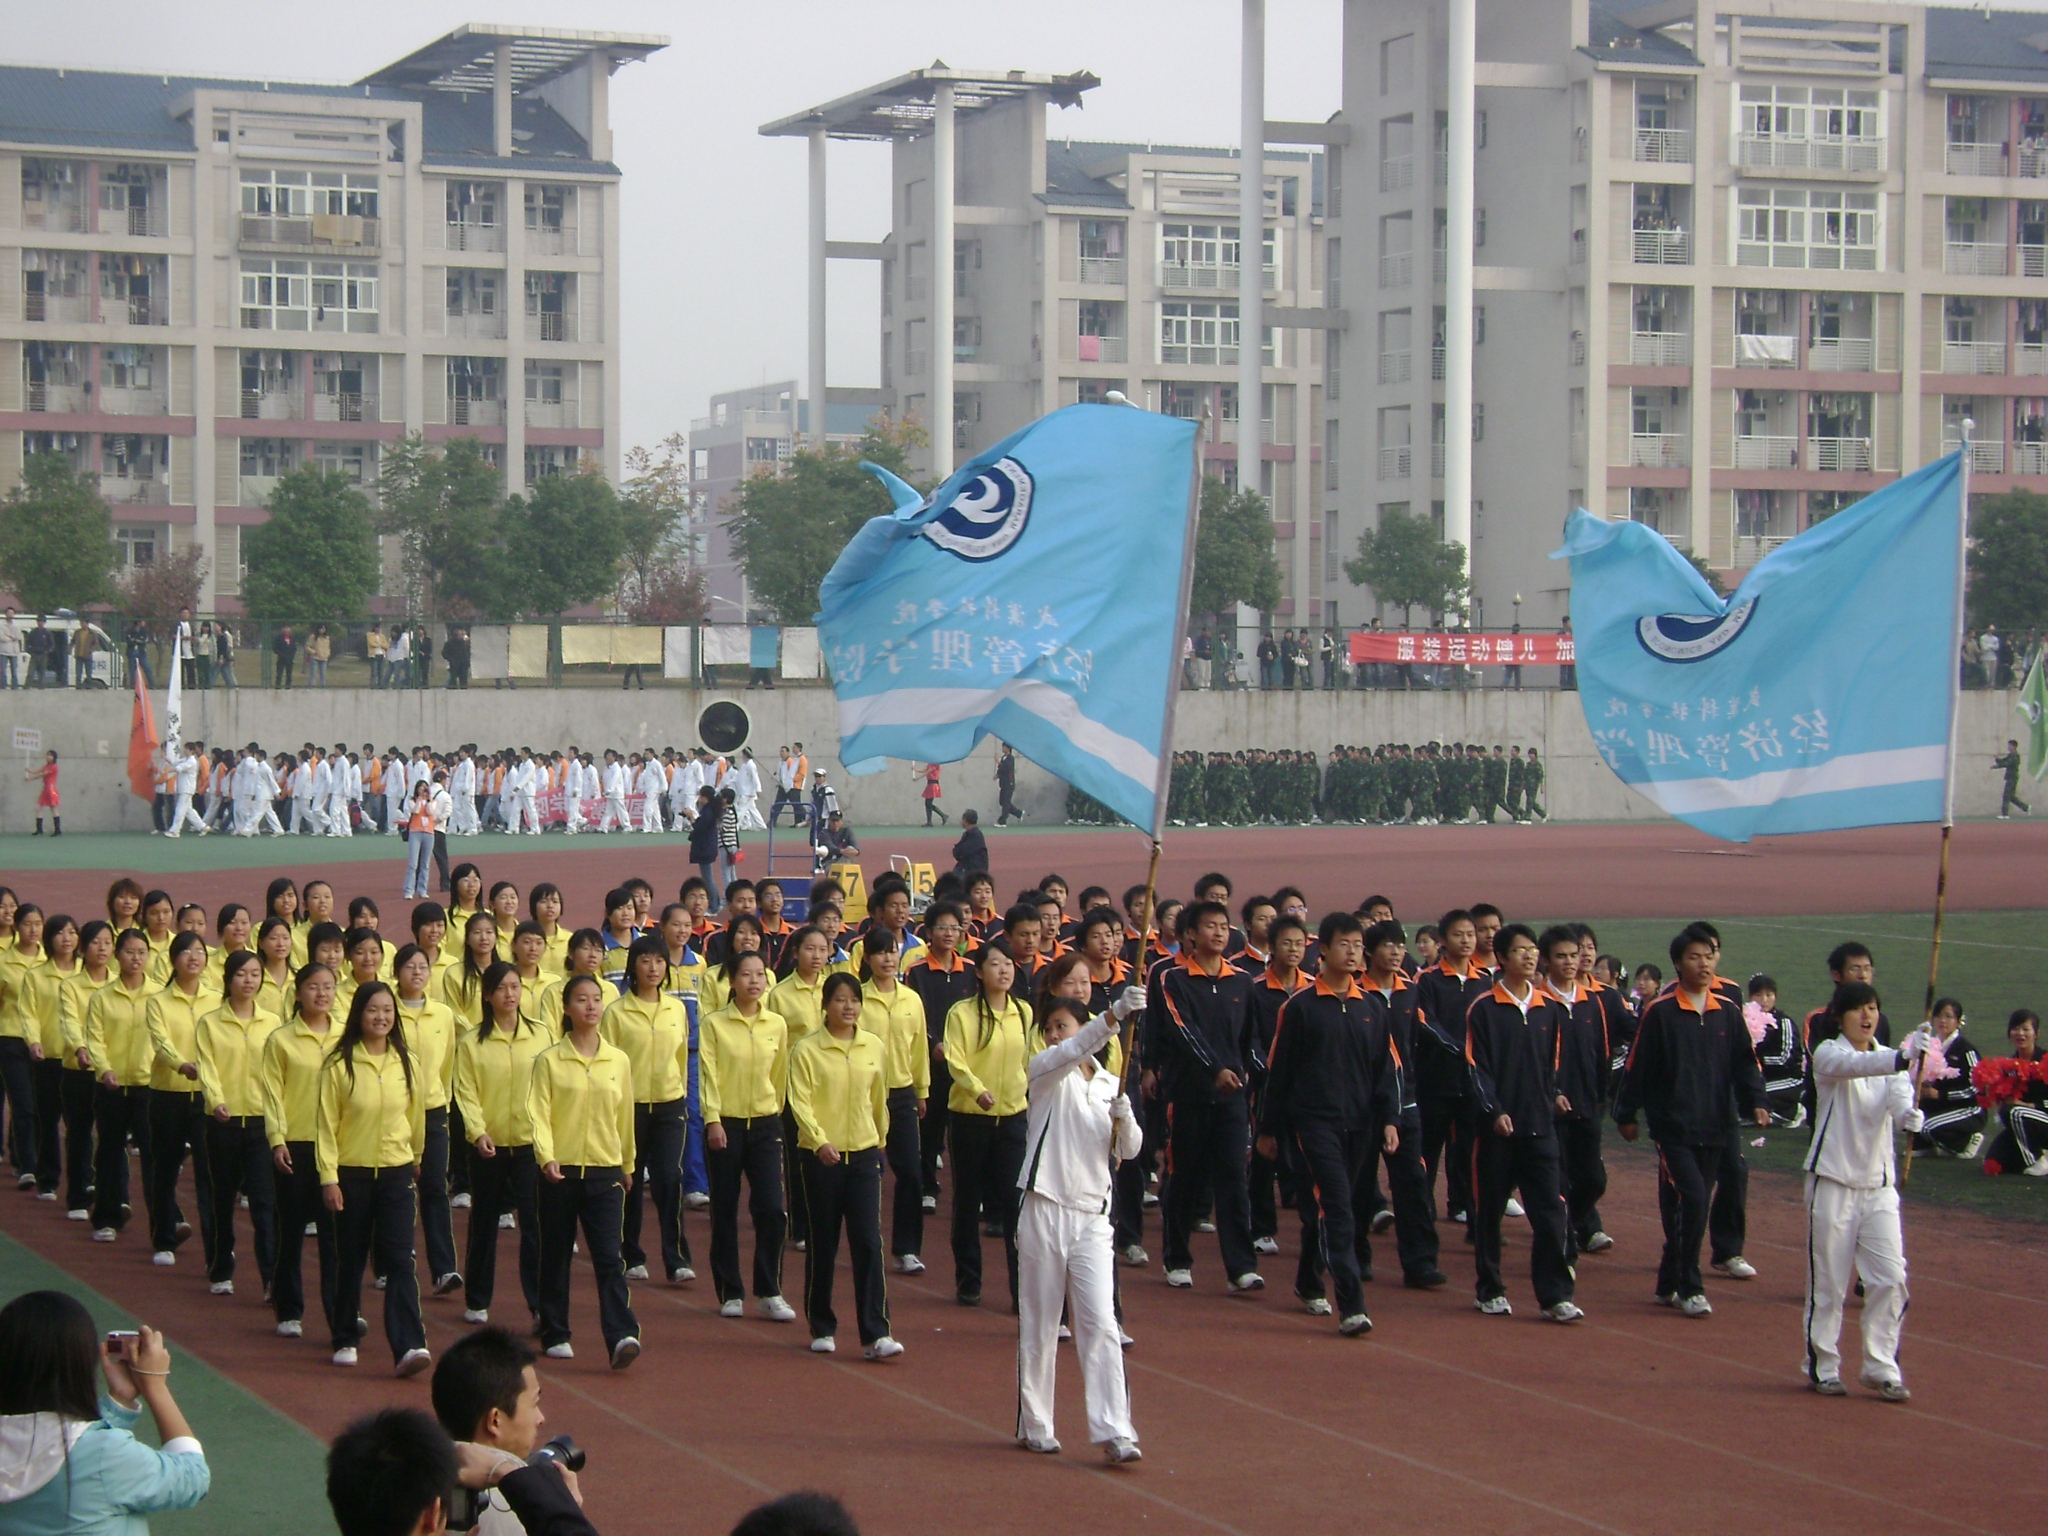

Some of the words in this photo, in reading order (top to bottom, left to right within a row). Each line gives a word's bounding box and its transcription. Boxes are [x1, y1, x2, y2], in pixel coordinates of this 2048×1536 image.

[1396, 637, 1538, 662] 服装运动健儿
[1555, 638, 1576, 661] 加
[846, 872, 859, 897] 7
[918, 871, 934, 897] 5
